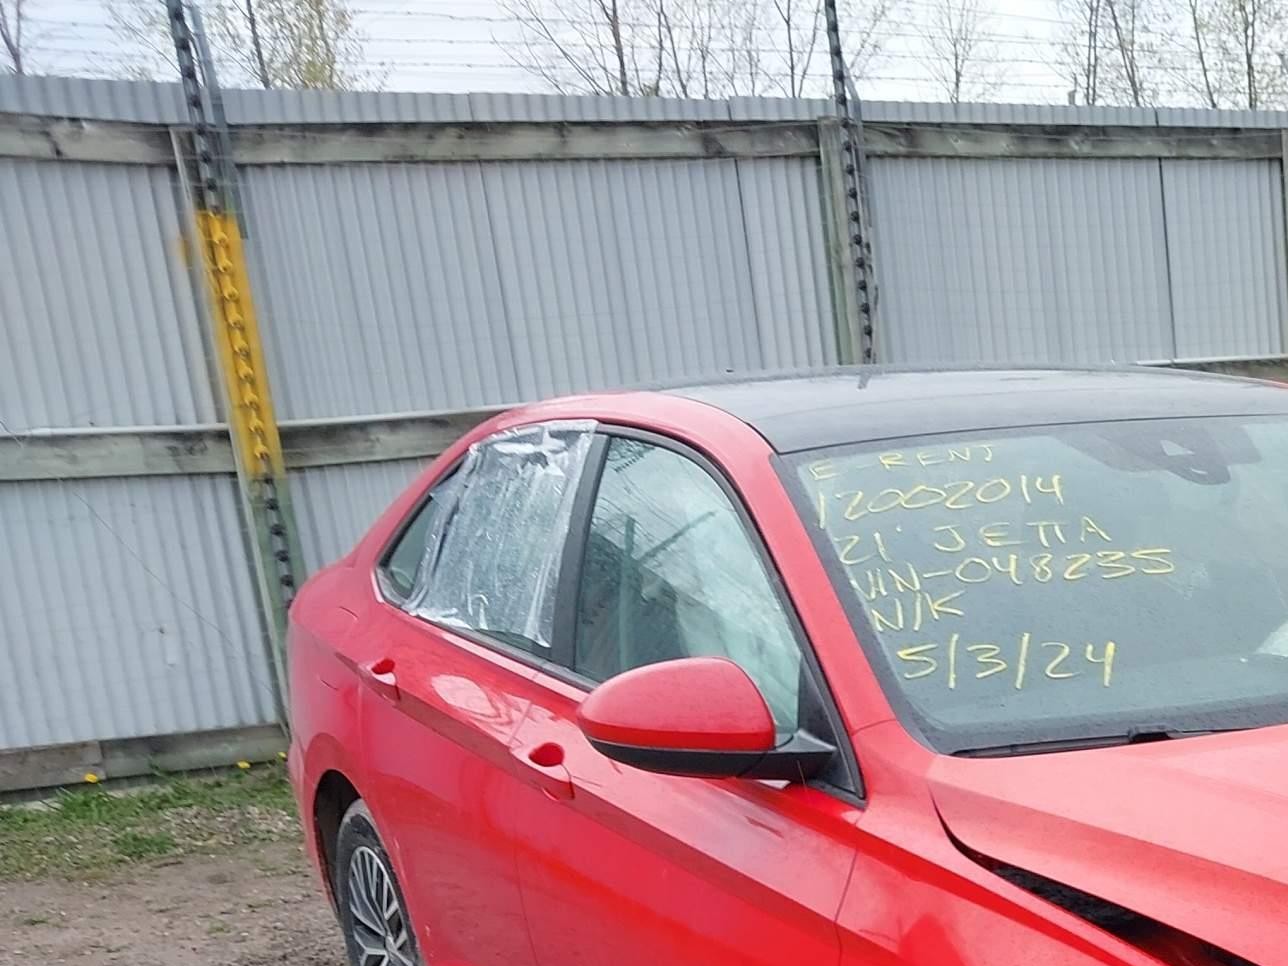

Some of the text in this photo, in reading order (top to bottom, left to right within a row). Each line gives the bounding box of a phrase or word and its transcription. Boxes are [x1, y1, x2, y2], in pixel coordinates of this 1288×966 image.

[817, 475, 1065, 529] 12002014
[933, 516, 1113, 552] JETTA
[896, 632, 1117, 690] 5/3/24
